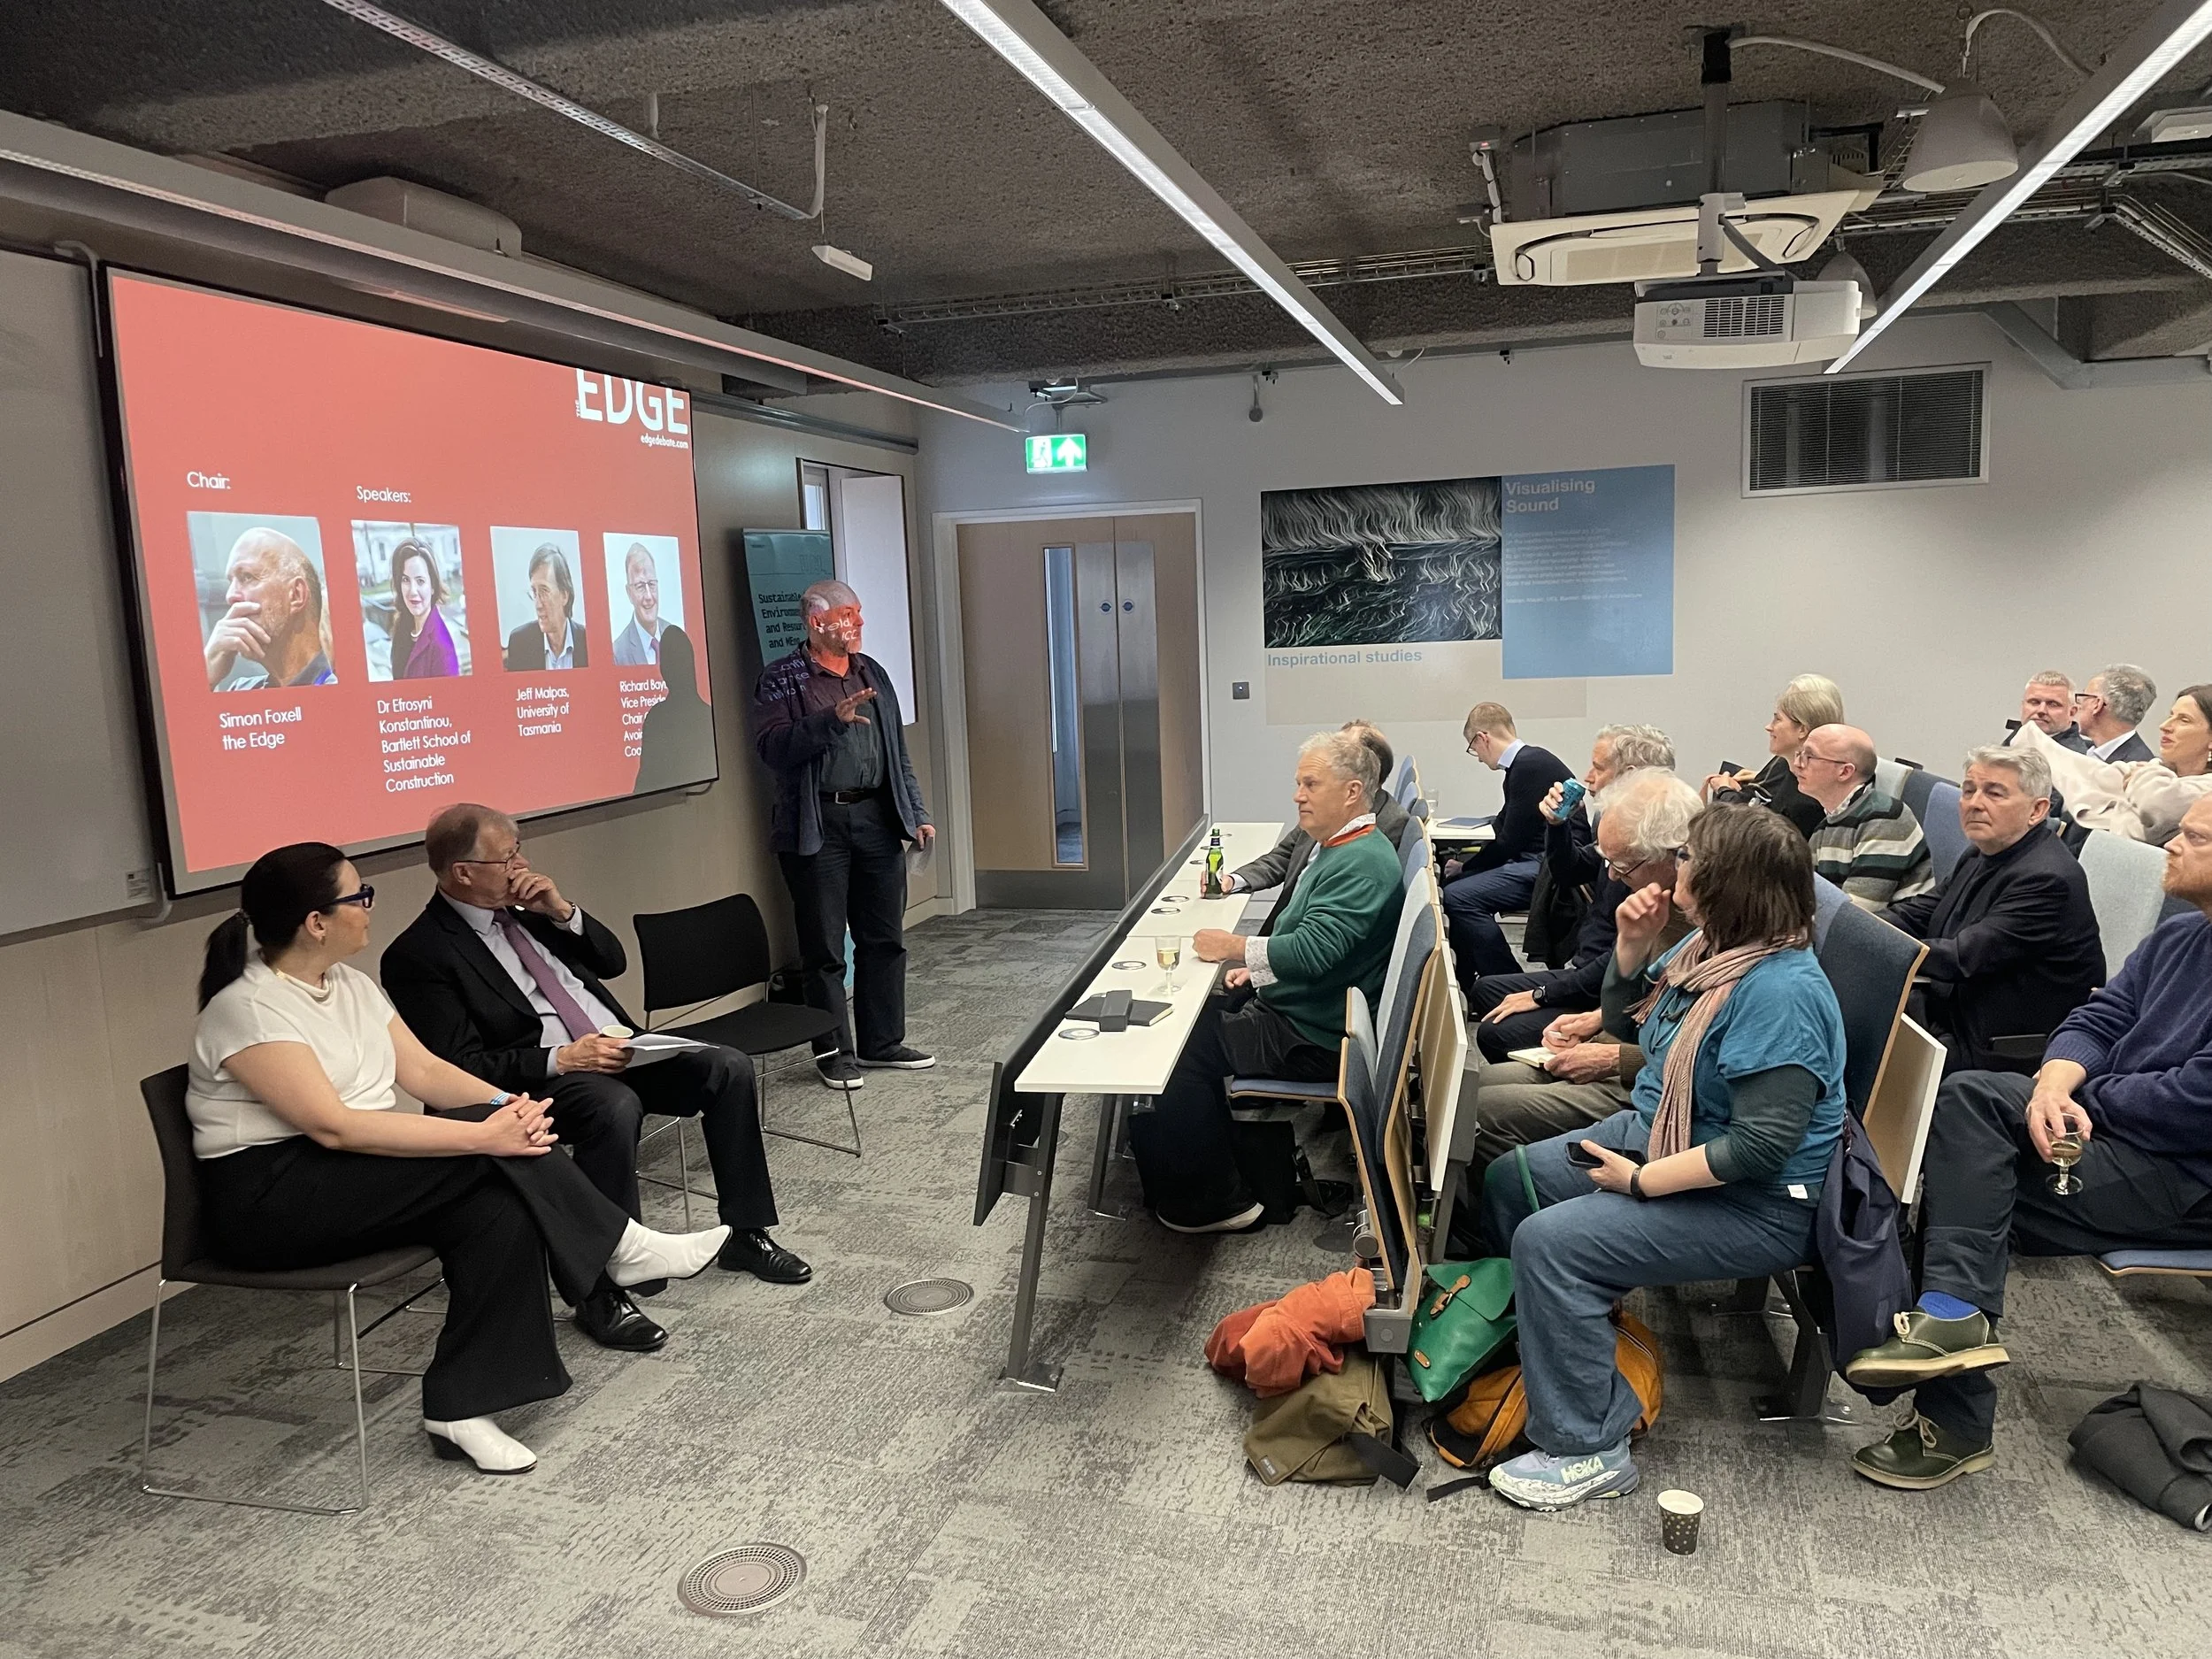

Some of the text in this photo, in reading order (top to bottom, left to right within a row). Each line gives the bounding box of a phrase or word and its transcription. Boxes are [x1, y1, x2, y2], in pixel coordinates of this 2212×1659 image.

[576, 368, 688, 434] EDGE
[640, 433, 689, 449] edgedebate.com
[356, 486, 411, 503] Speakers:
[1505, 478, 1595, 495] Visualising
[1506, 496, 1559, 513] Sound
[765, 623, 780, 634] and
[768, 638, 784, 648] and
[1268, 649, 1423, 669] Inspirational studies
[516, 686, 570, 702] Jeff Malpas,
[619, 680, 649, 693] Richard
[377, 695, 433, 714] Dr Efrosyni
[517, 702, 570, 719] University of
[620, 697, 639, 709] Vice
[219, 706, 303, 728] Simon Foxell
[379, 716, 453, 734] Konstantinou,
[622, 711, 643, 726] Chair
[518, 720, 562, 737] Tasmania
[222, 731, 286, 750] the Edge
[380, 730, 472, 754] Bartlett School of
[383, 753, 446, 773] Sustainable
[385, 772, 455, 793] Construction
[1560, 1455, 1605, 1485] HOKA
